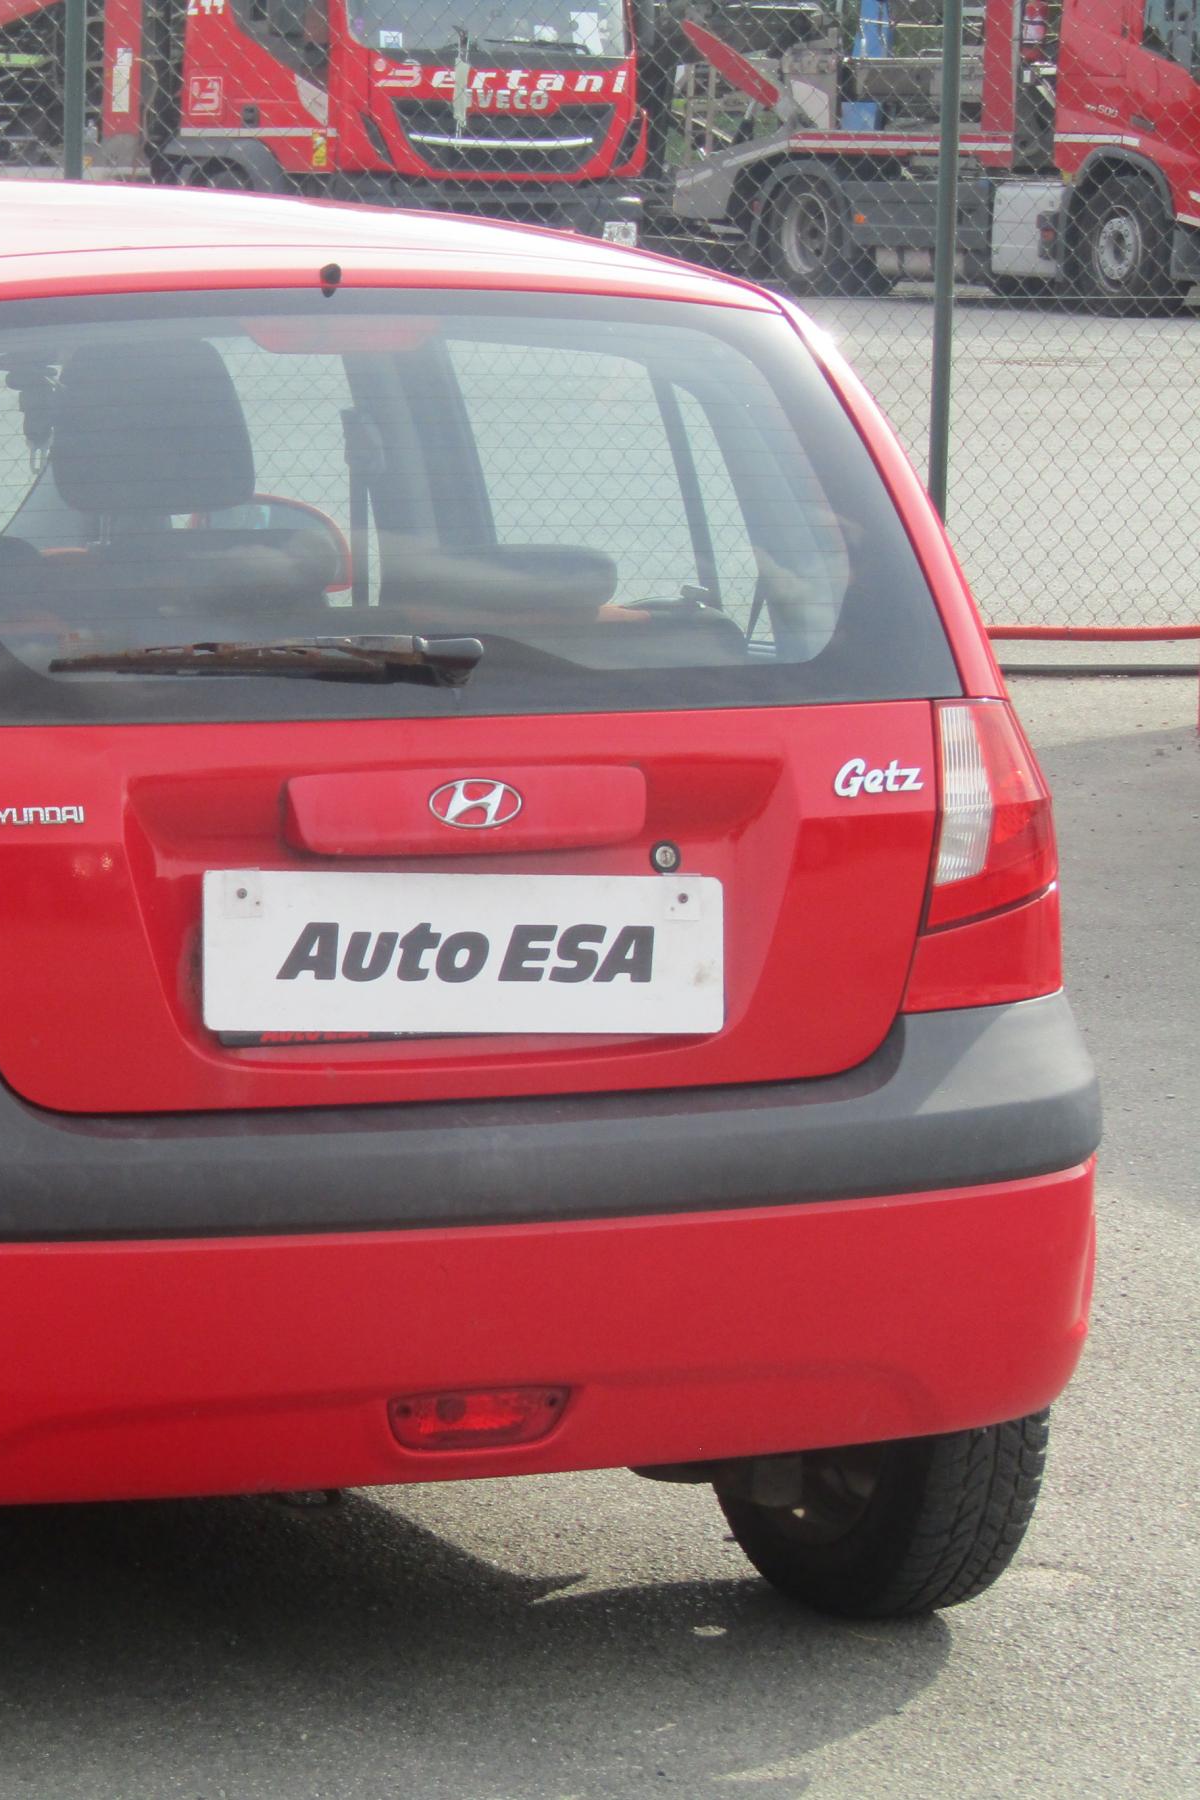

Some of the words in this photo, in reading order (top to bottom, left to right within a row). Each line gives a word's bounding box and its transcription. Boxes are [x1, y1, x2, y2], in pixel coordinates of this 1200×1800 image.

[374, 58, 627, 93] Bertani
[834, 758, 924, 797] Getz
[276, 922, 490, 983] Auto
[497, 924, 655, 983] ESA
